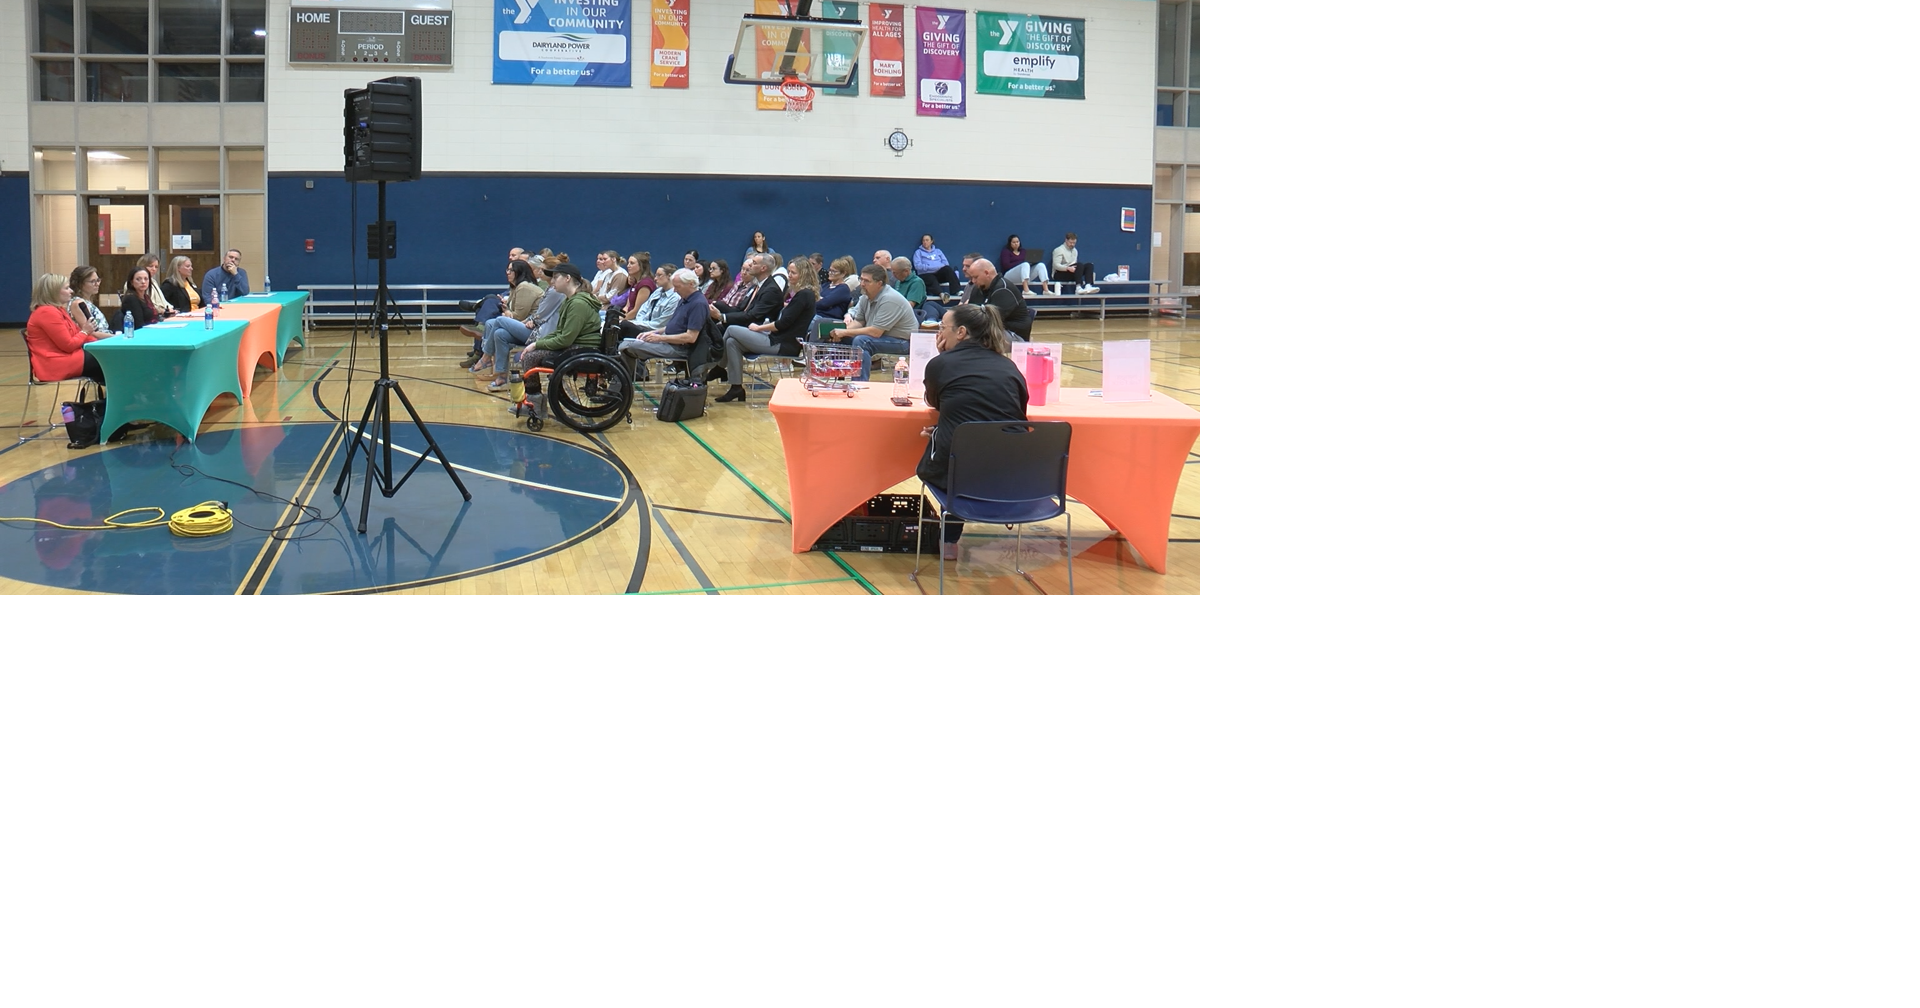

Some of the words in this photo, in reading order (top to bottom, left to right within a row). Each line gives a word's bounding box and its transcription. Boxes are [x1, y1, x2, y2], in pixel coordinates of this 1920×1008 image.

[566, 7, 578, 15] IN
[582, 8, 606, 17] OUR
[296, 13, 330, 23] HOME
[411, 15, 449, 25] GUEST
[548, 18, 624, 29] COMMUNITY
[1026, 21, 1072, 34] GIVING
[768, 30, 777, 38] IN
[923, 32, 960, 42] GIVING
[1027, 43, 1071, 51] DISCOVERY
[1013, 55, 1055, 69] emplify
